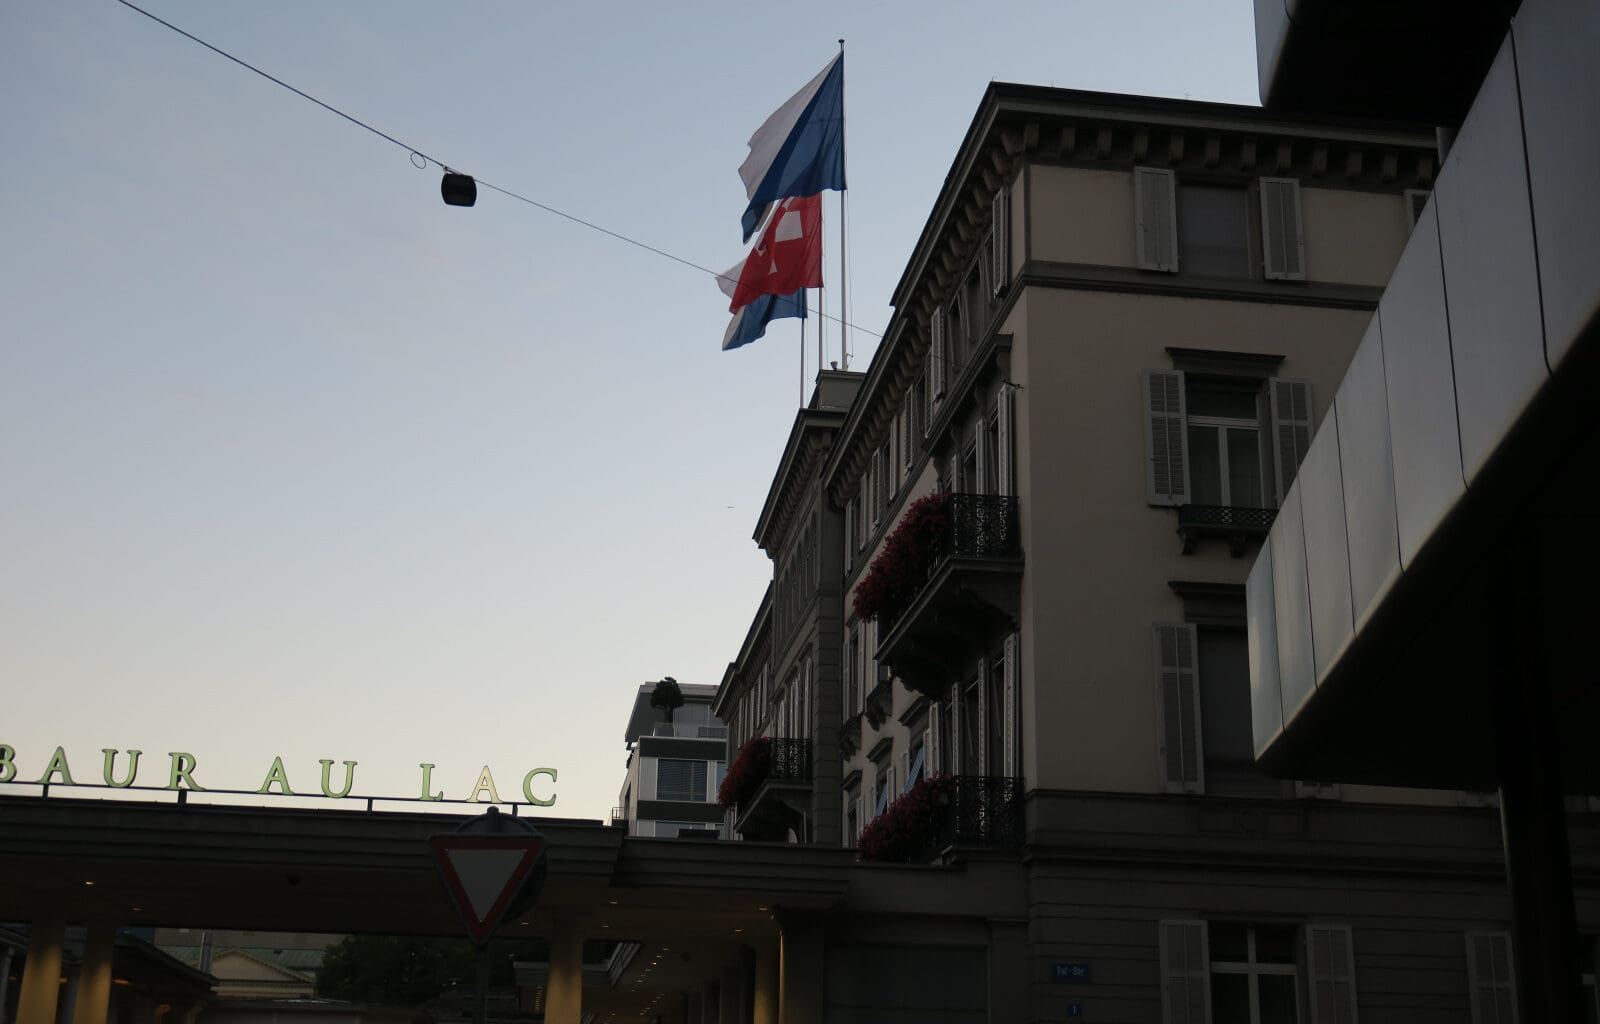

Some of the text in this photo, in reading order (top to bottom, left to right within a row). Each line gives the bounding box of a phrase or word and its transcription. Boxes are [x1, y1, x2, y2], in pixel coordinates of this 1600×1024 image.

[0, 744, 558, 806] BAUR AU LAC
